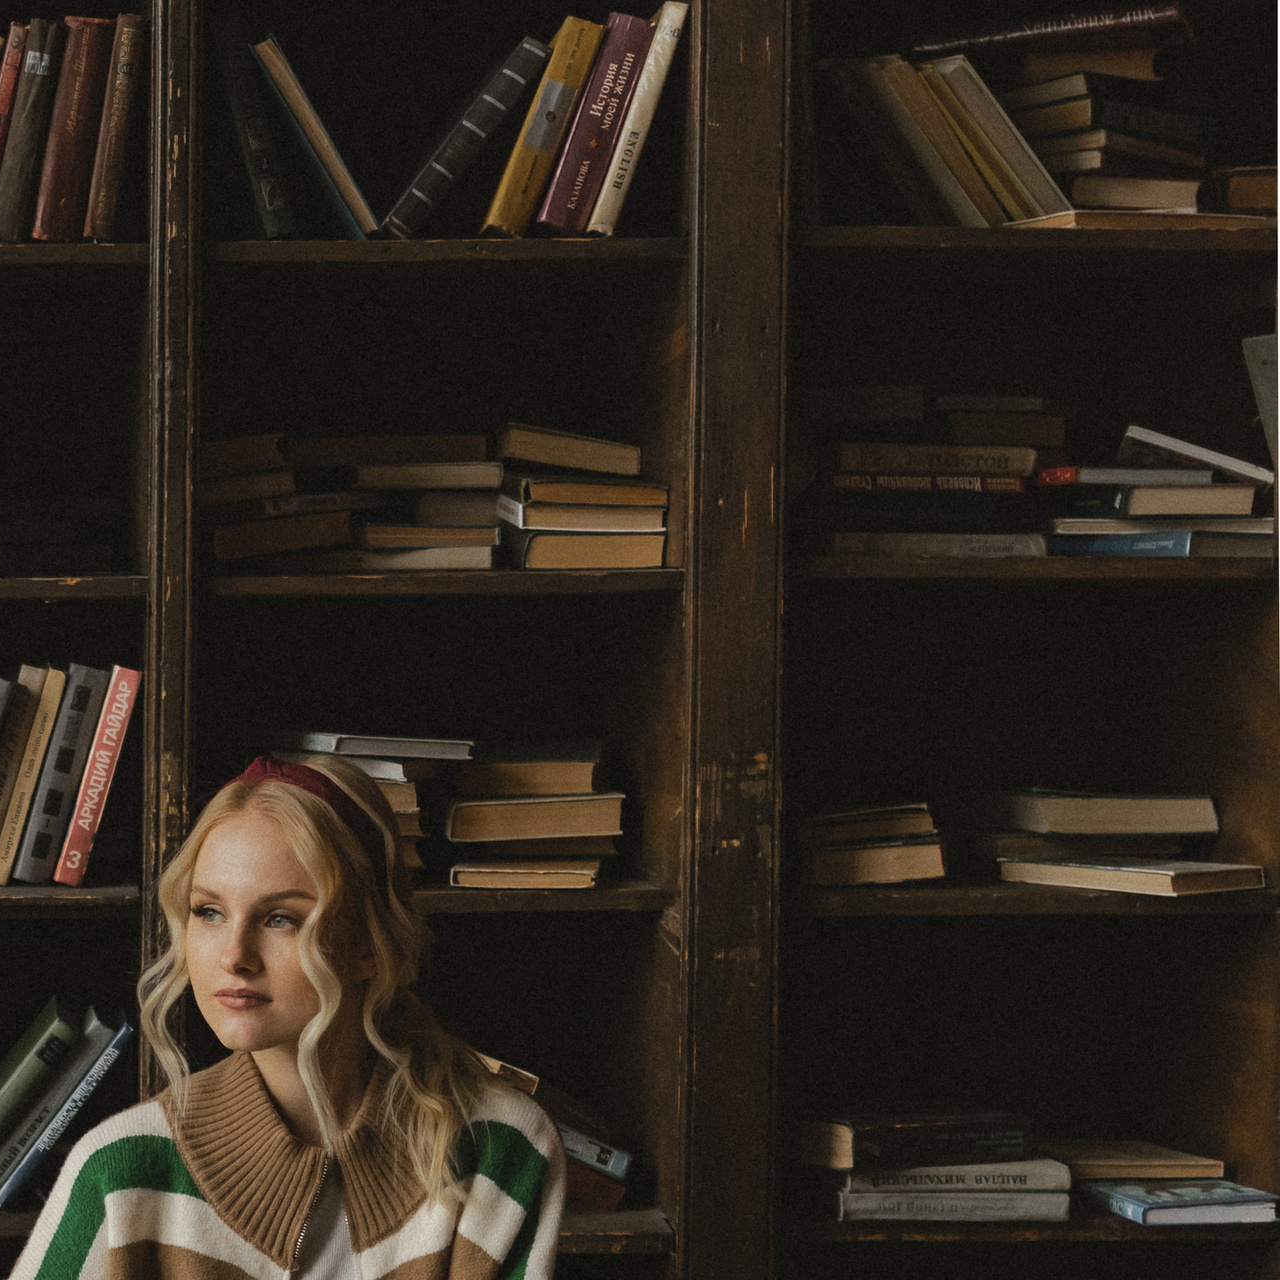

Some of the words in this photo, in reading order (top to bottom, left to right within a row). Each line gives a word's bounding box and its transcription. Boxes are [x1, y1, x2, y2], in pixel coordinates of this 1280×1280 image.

[587, 60, 624, 118] История
[595, 95, 622, 131] моей
[609, 50, 639, 95] жизни
[562, 157, 595, 211] КАЗАНОВА
[610, 129, 640, 191] ENGLISH
[72, 747, 116, 832] АРКАДИЙ
[99, 679, 137, 748] ГАЙДАР
[973, 1173, 1028, 1186] ВАЦЛАВ
